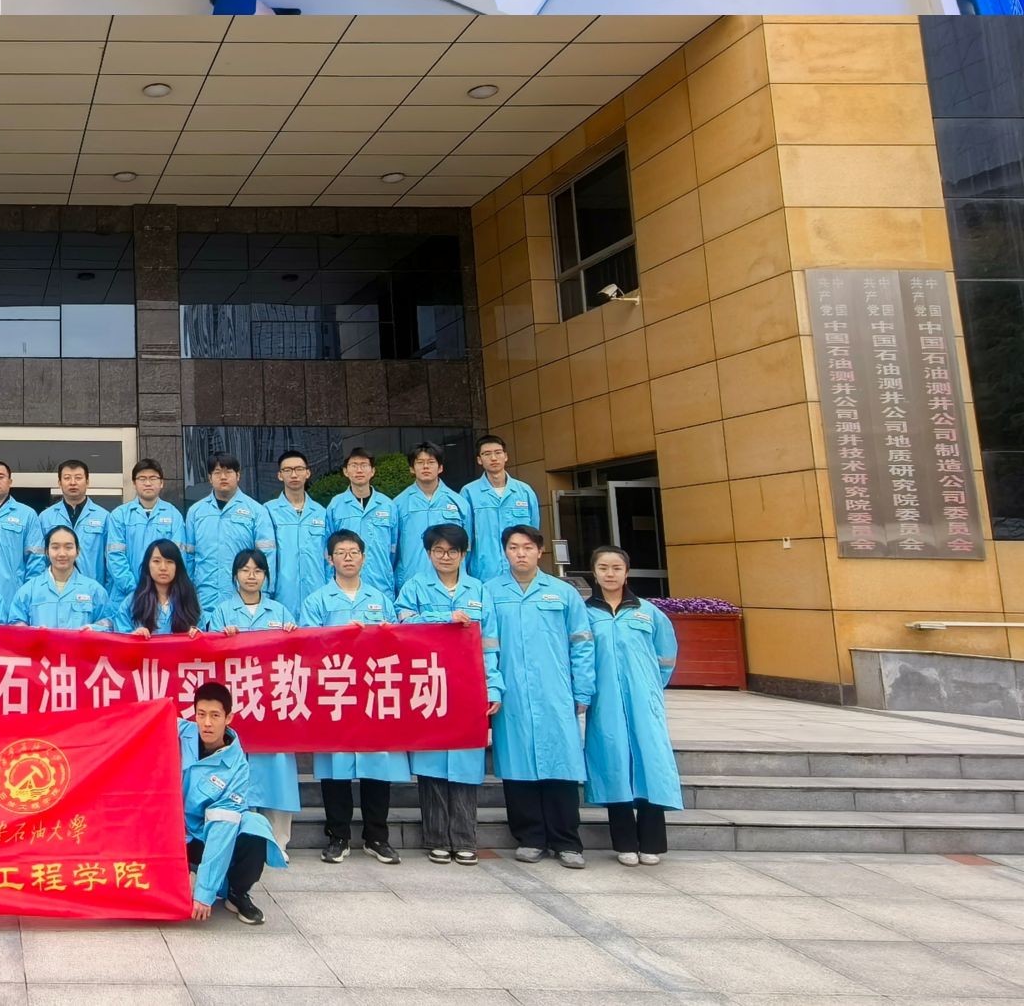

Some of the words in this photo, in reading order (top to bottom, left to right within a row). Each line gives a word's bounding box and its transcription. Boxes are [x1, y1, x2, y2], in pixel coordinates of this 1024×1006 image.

[824, 320, 877, 551] 中国石油测井公司测井技术研究院委员会
[870, 321, 925, 552] 中国石油测井公司地质研究院委员会
[918, 321, 976, 552] 中国石油测井公司制造公司委员会
